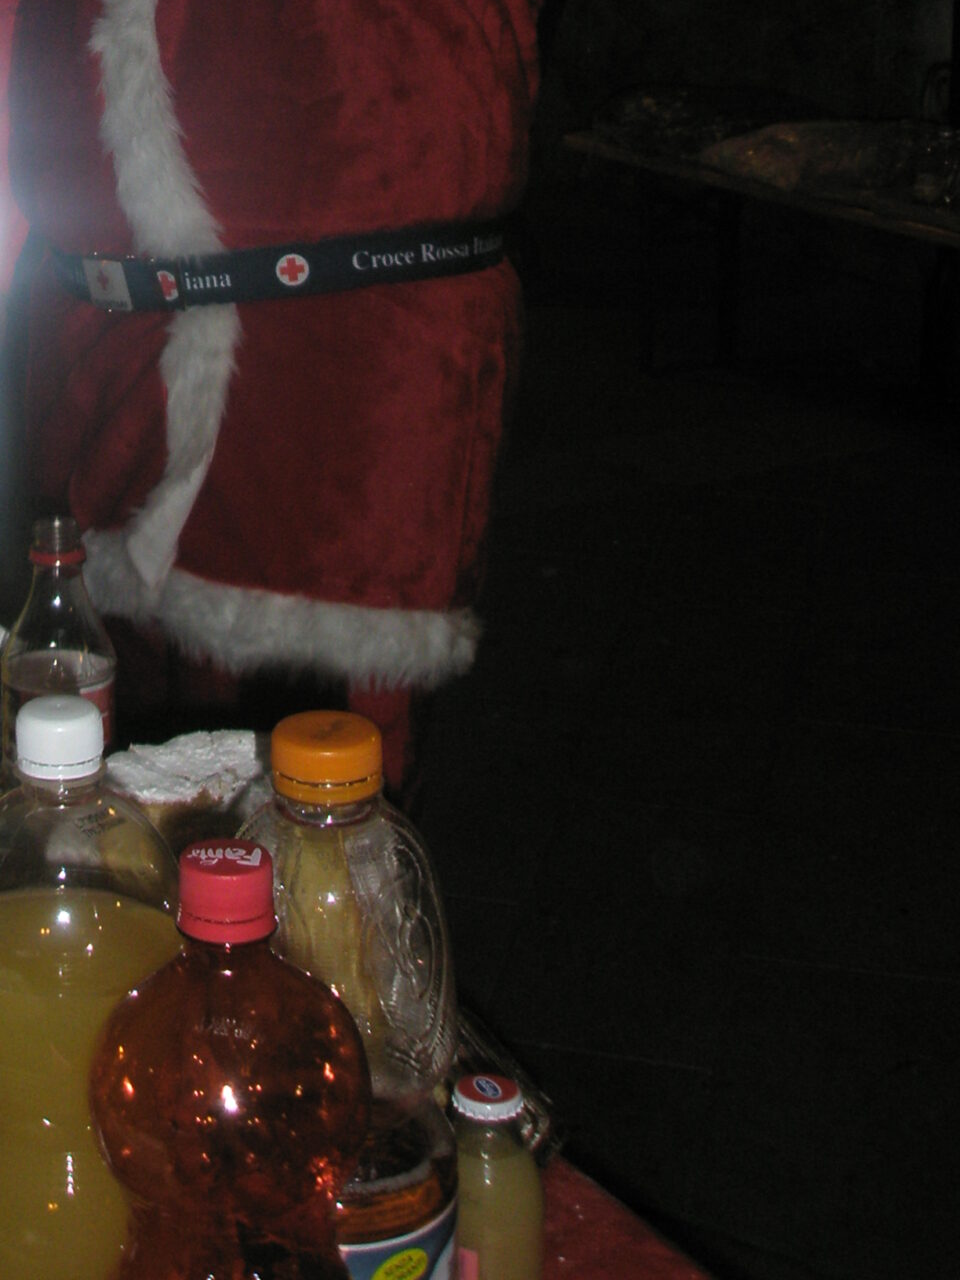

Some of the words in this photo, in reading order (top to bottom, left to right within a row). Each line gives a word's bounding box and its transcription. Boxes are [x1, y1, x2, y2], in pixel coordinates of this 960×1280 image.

[352, 250, 415, 270] Croce
[421, 242, 470, 263] Rossa
[187, 847, 263, 867] Fanta
